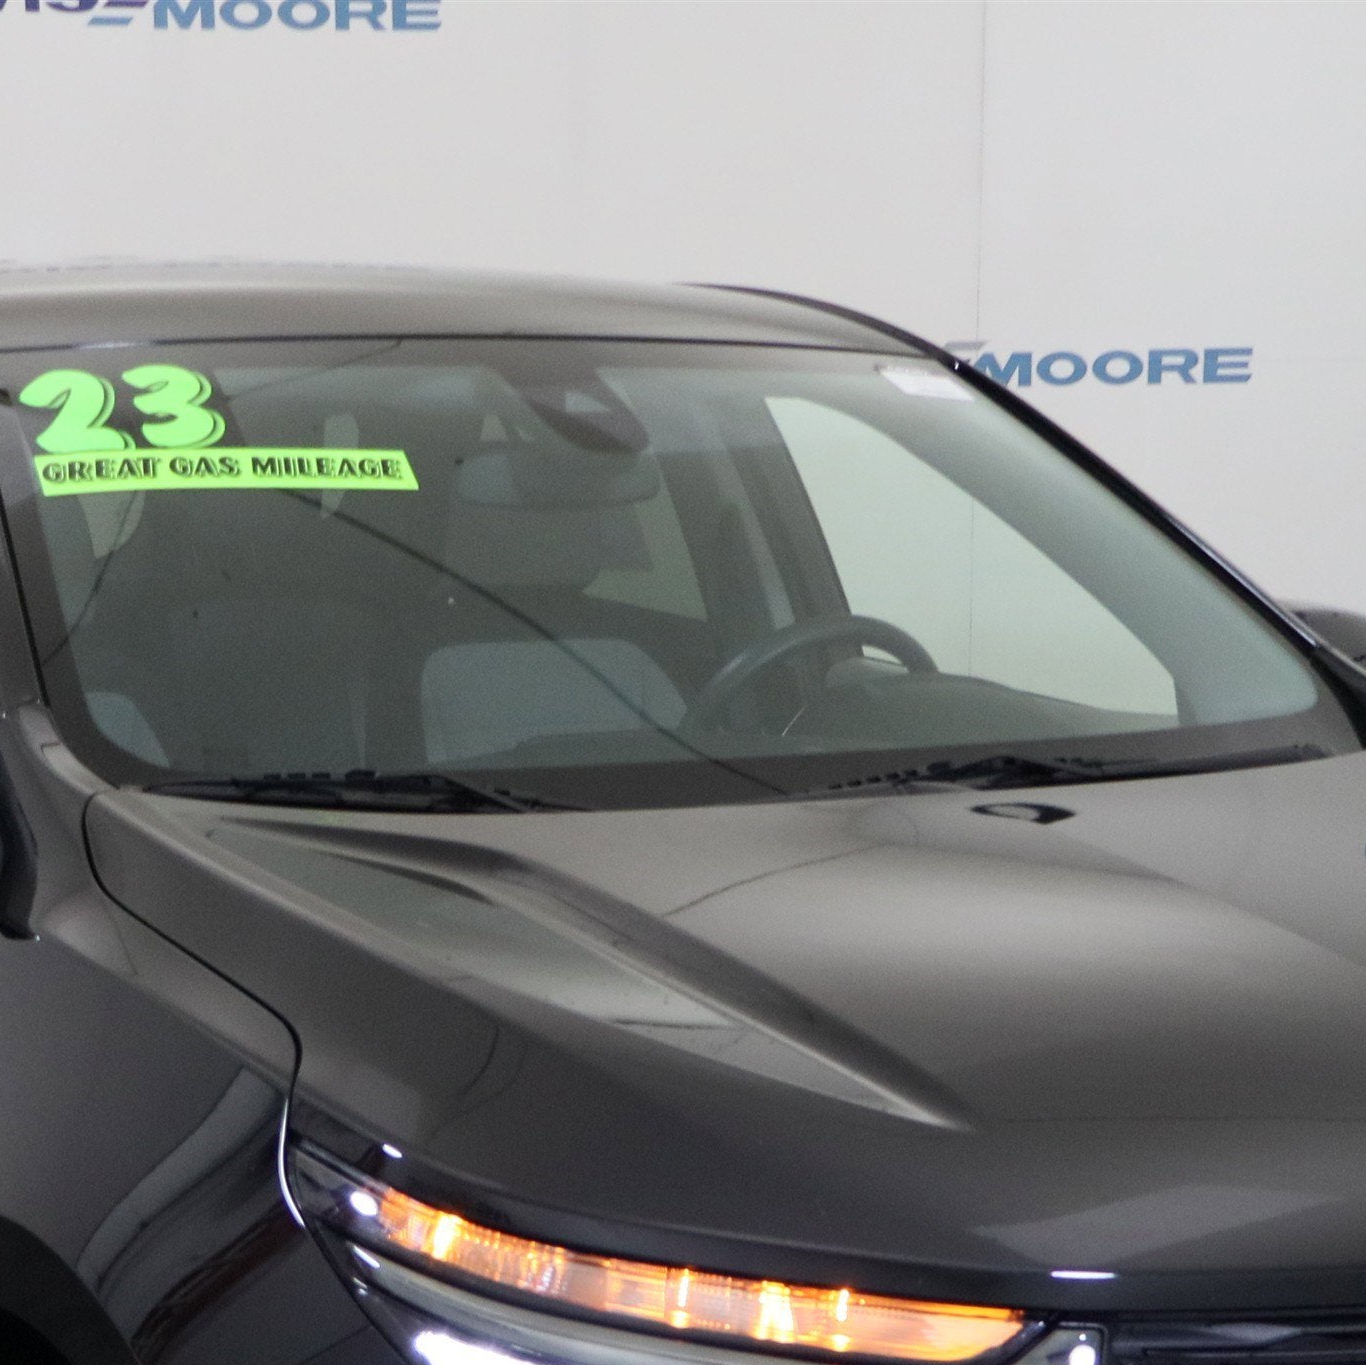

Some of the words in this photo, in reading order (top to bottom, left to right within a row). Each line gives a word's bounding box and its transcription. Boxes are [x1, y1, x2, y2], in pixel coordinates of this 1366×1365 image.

[153, 0, 441, 30] MOORE
[974, 347, 1253, 387] MOORE
[19, 364, 225, 452] 23
[42, 456, 161, 484] GREAT
[169, 456, 241, 478] GAS
[251, 456, 403, 480] MILEAGE
